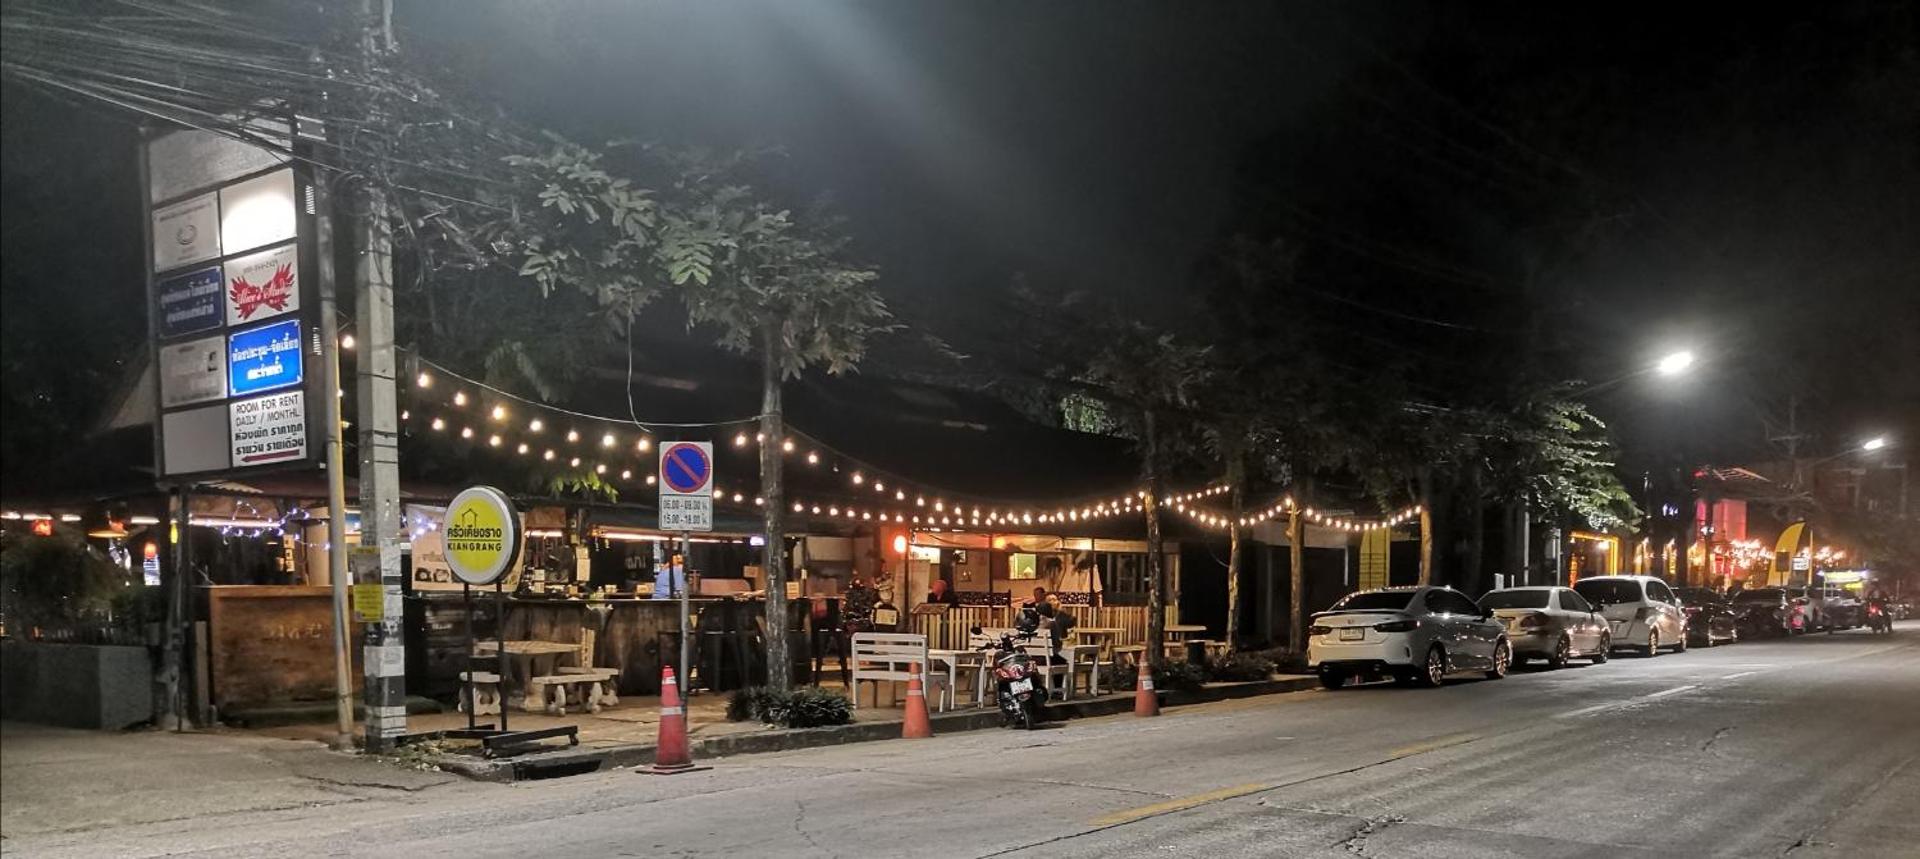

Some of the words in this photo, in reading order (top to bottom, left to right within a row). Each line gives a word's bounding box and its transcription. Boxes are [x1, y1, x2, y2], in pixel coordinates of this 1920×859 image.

[236, 402, 259, 414] ROOM
[261, 398, 276, 410] FOR
[279, 394, 298, 406] RENT
[236, 415, 257, 426] DAILY
[235, 426, 268, 441] ห้องพัก
[235, 441, 264, 455] รายวัน
[266, 436, 304, 451] รายเดือน
[447, 542, 502, 552] KIANGRANG
